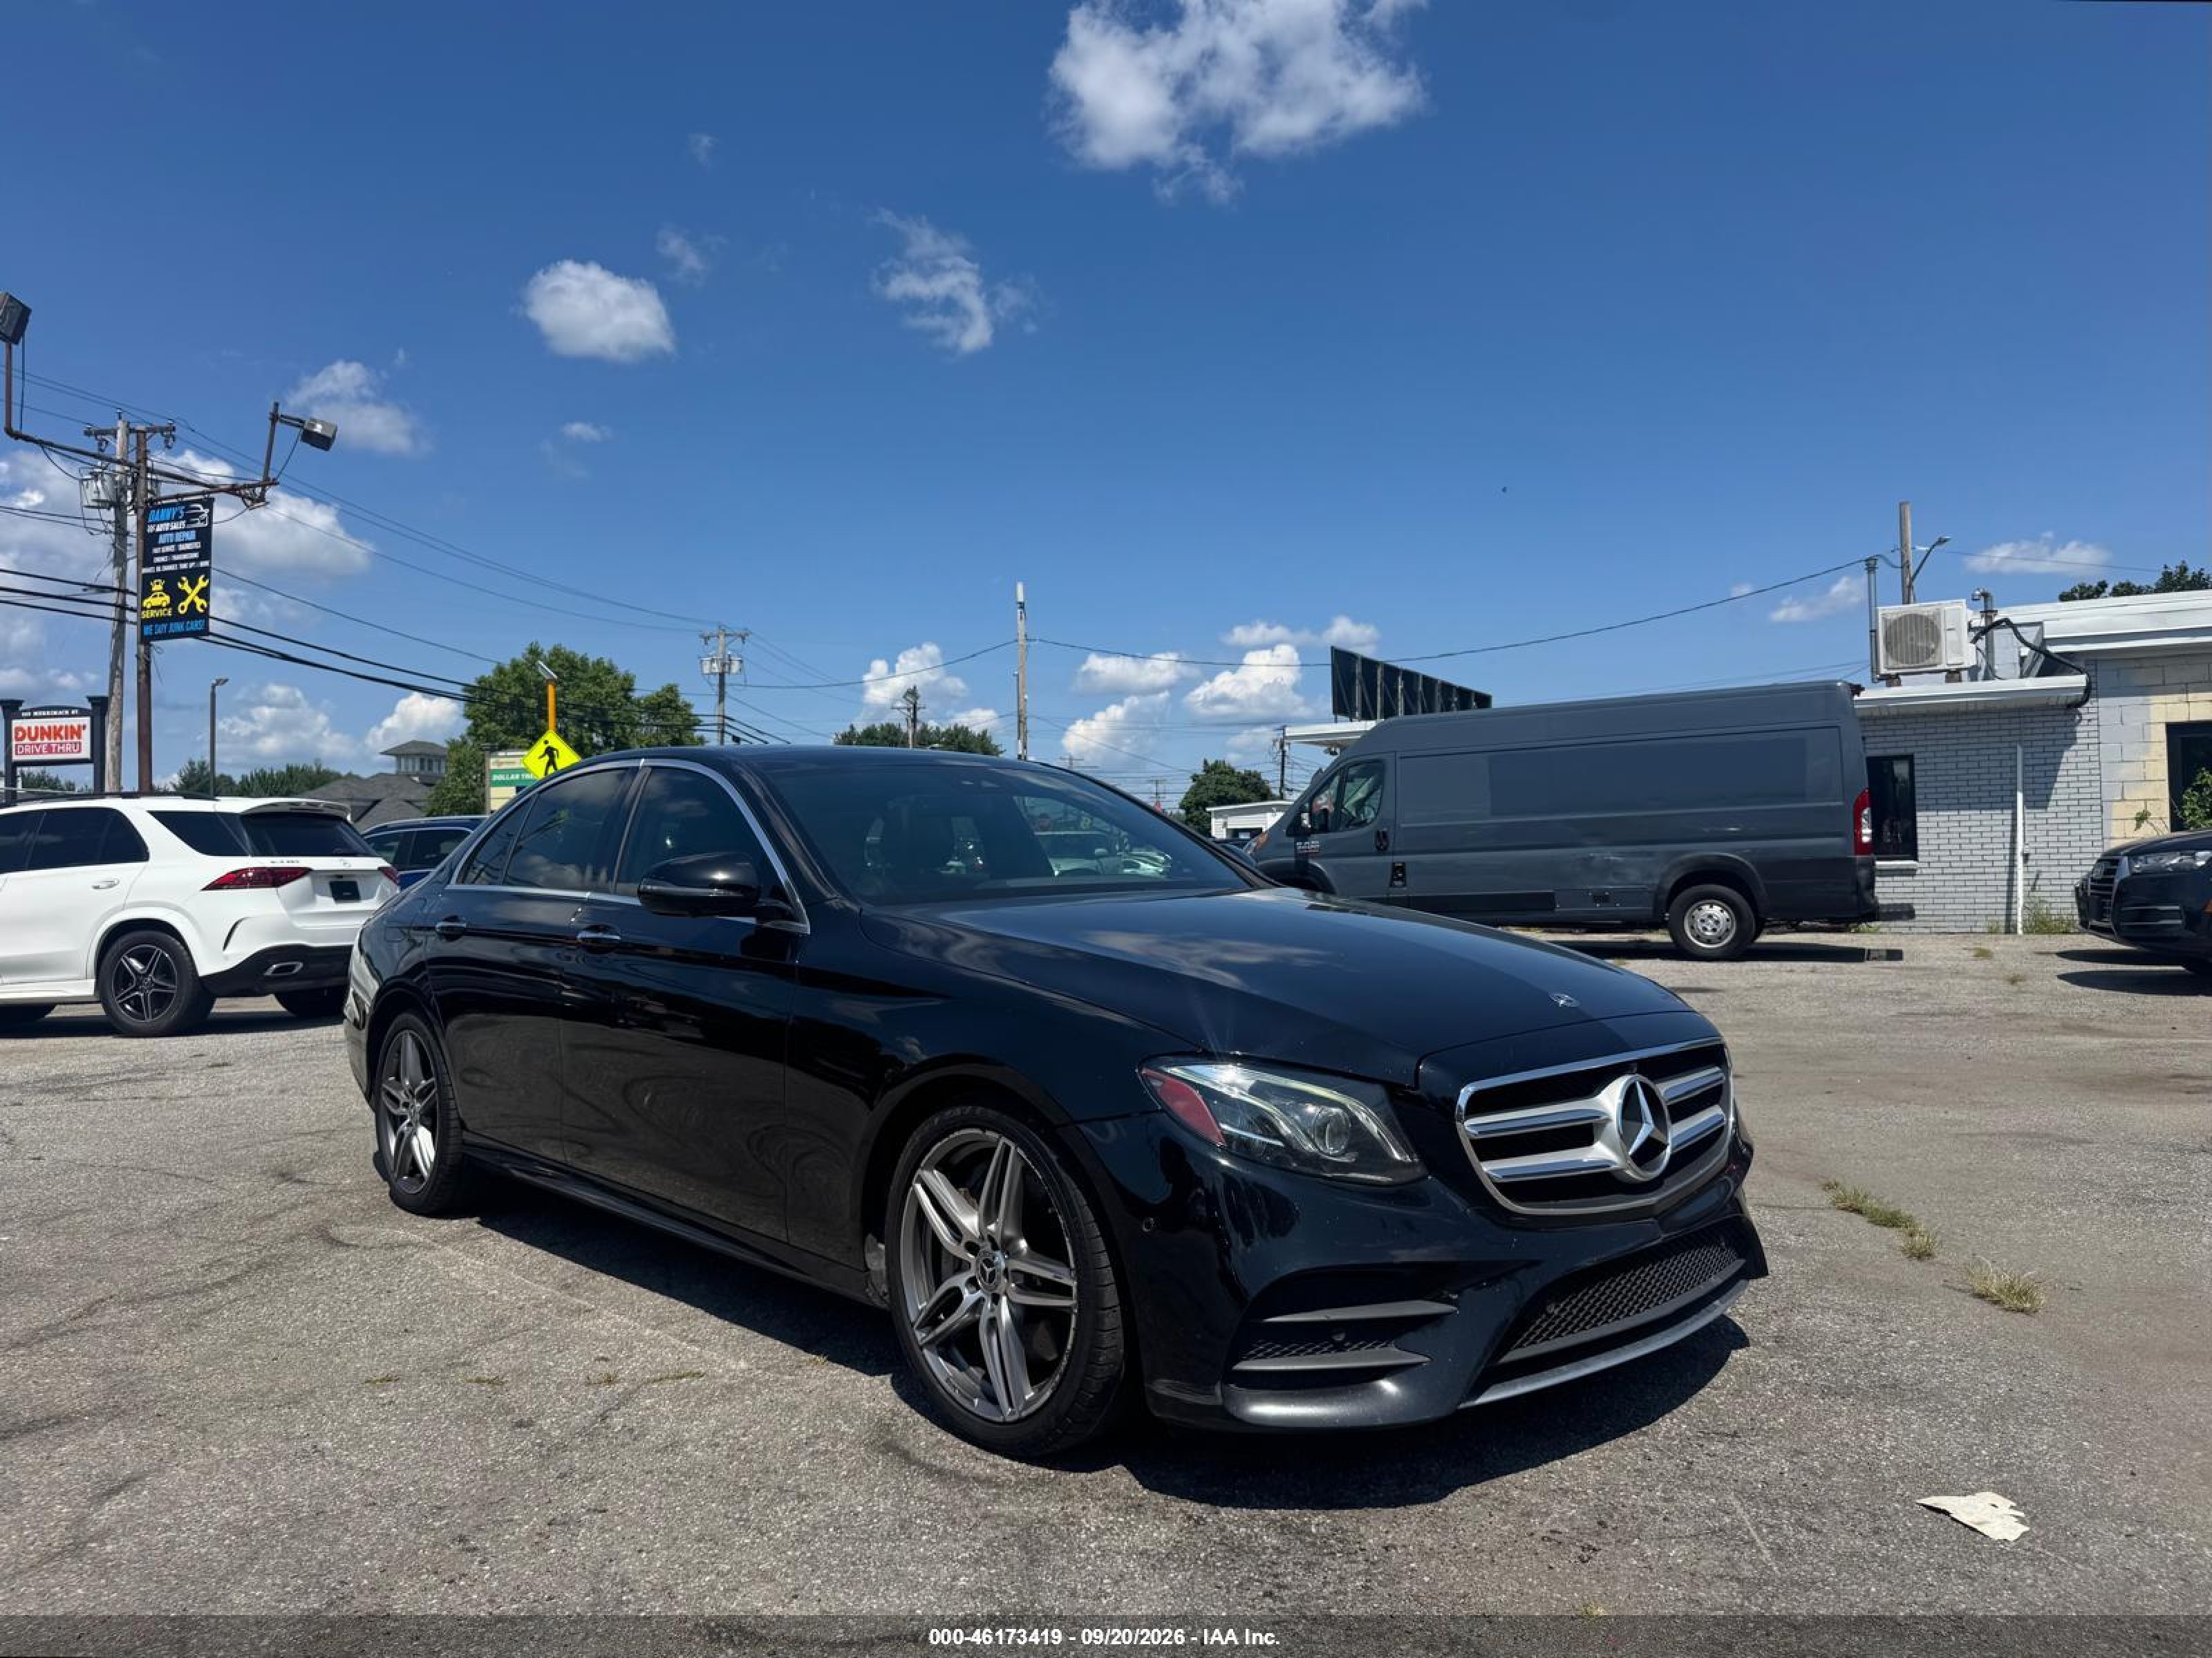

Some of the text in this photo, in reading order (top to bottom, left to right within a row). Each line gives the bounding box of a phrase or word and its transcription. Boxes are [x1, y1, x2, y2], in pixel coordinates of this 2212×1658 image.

[141, 608, 172, 618] SERVICE
[15, 724, 86, 742] DUNKIN'
[17, 743, 79, 754] DRIVE THRU
